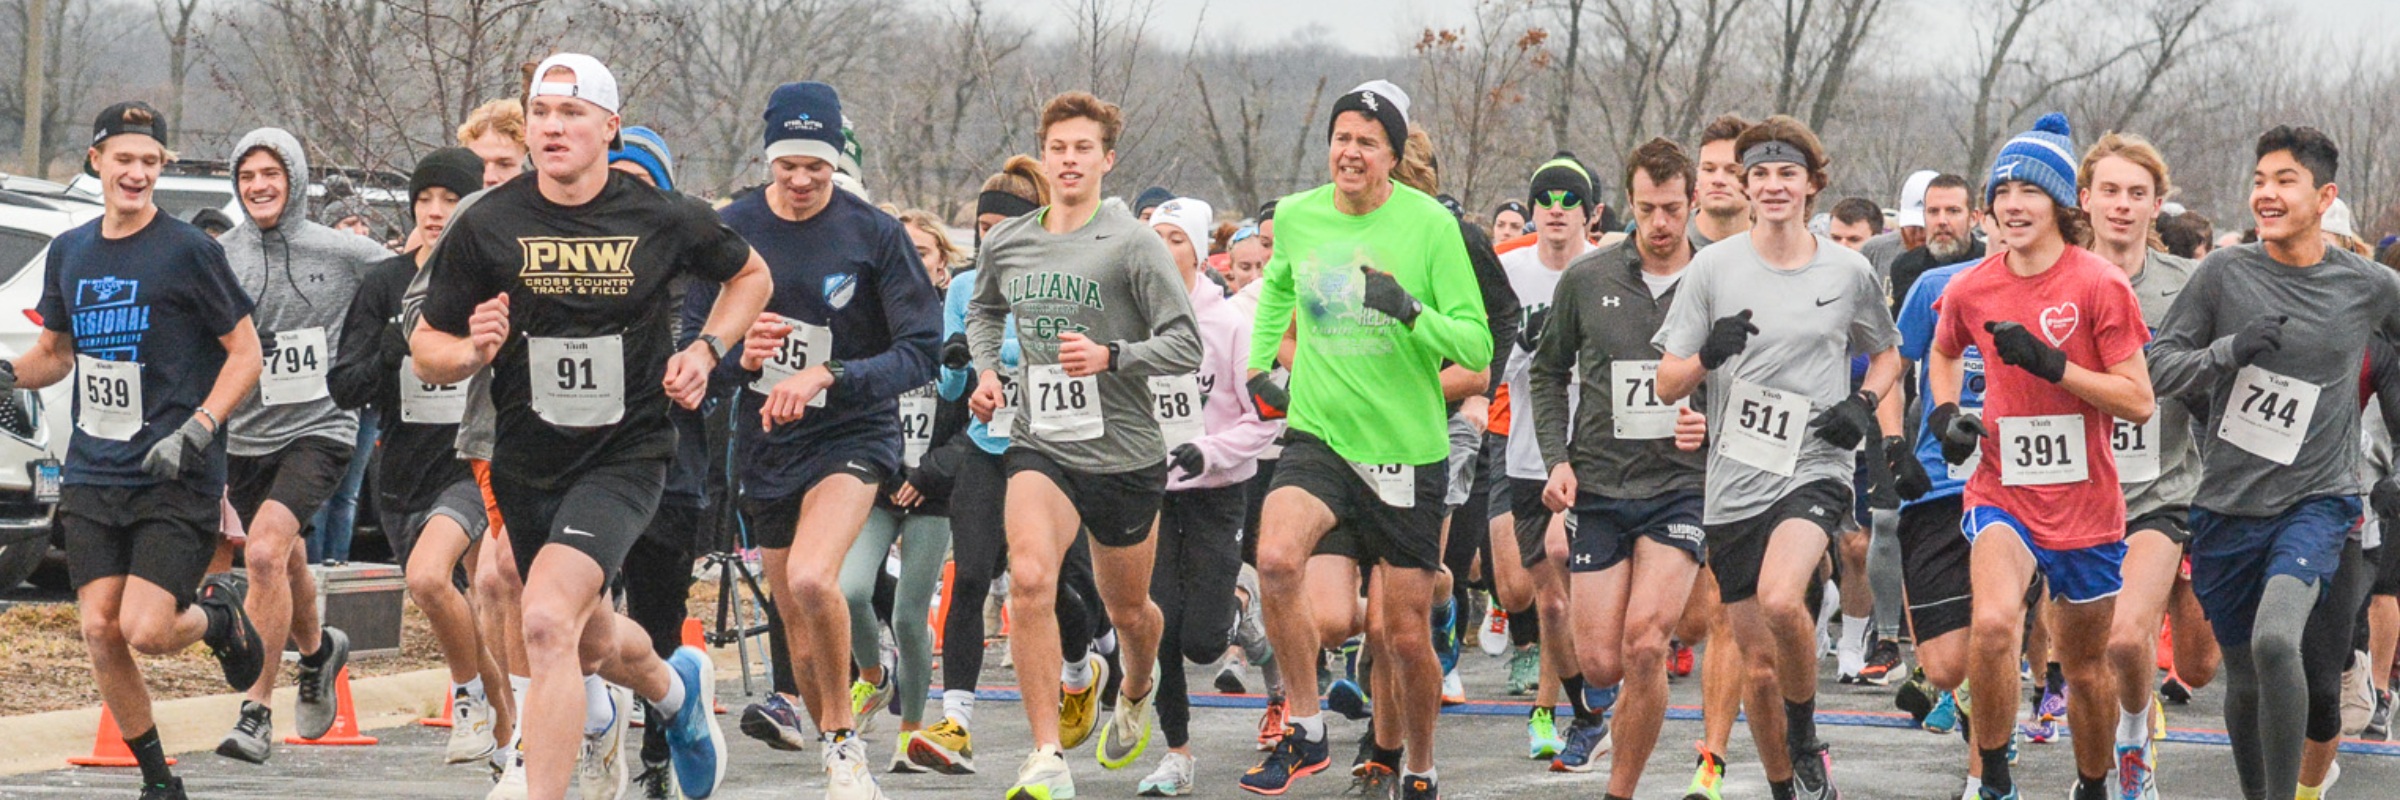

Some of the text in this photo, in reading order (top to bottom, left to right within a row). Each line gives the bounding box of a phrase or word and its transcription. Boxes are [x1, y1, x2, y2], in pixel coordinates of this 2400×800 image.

[528, 242, 629, 271] PNW
[525, 278, 636, 287] CROSS COUNTRY
[532, 286, 629, 295] TRACK & FIELD
[271, 345, 319, 375] 794
[557, 357, 598, 391] 91
[86, 374, 130, 408] 539
[1038, 380, 1087, 412] 718
[1625, 378, 1659, 408] 71
[2240, 383, 2300, 429] 744
[902, 412, 930, 440] 42
[1739, 398, 1791, 441] 511
[2013, 433, 2072, 468] 391
[2113, 422, 2146, 451] 51
